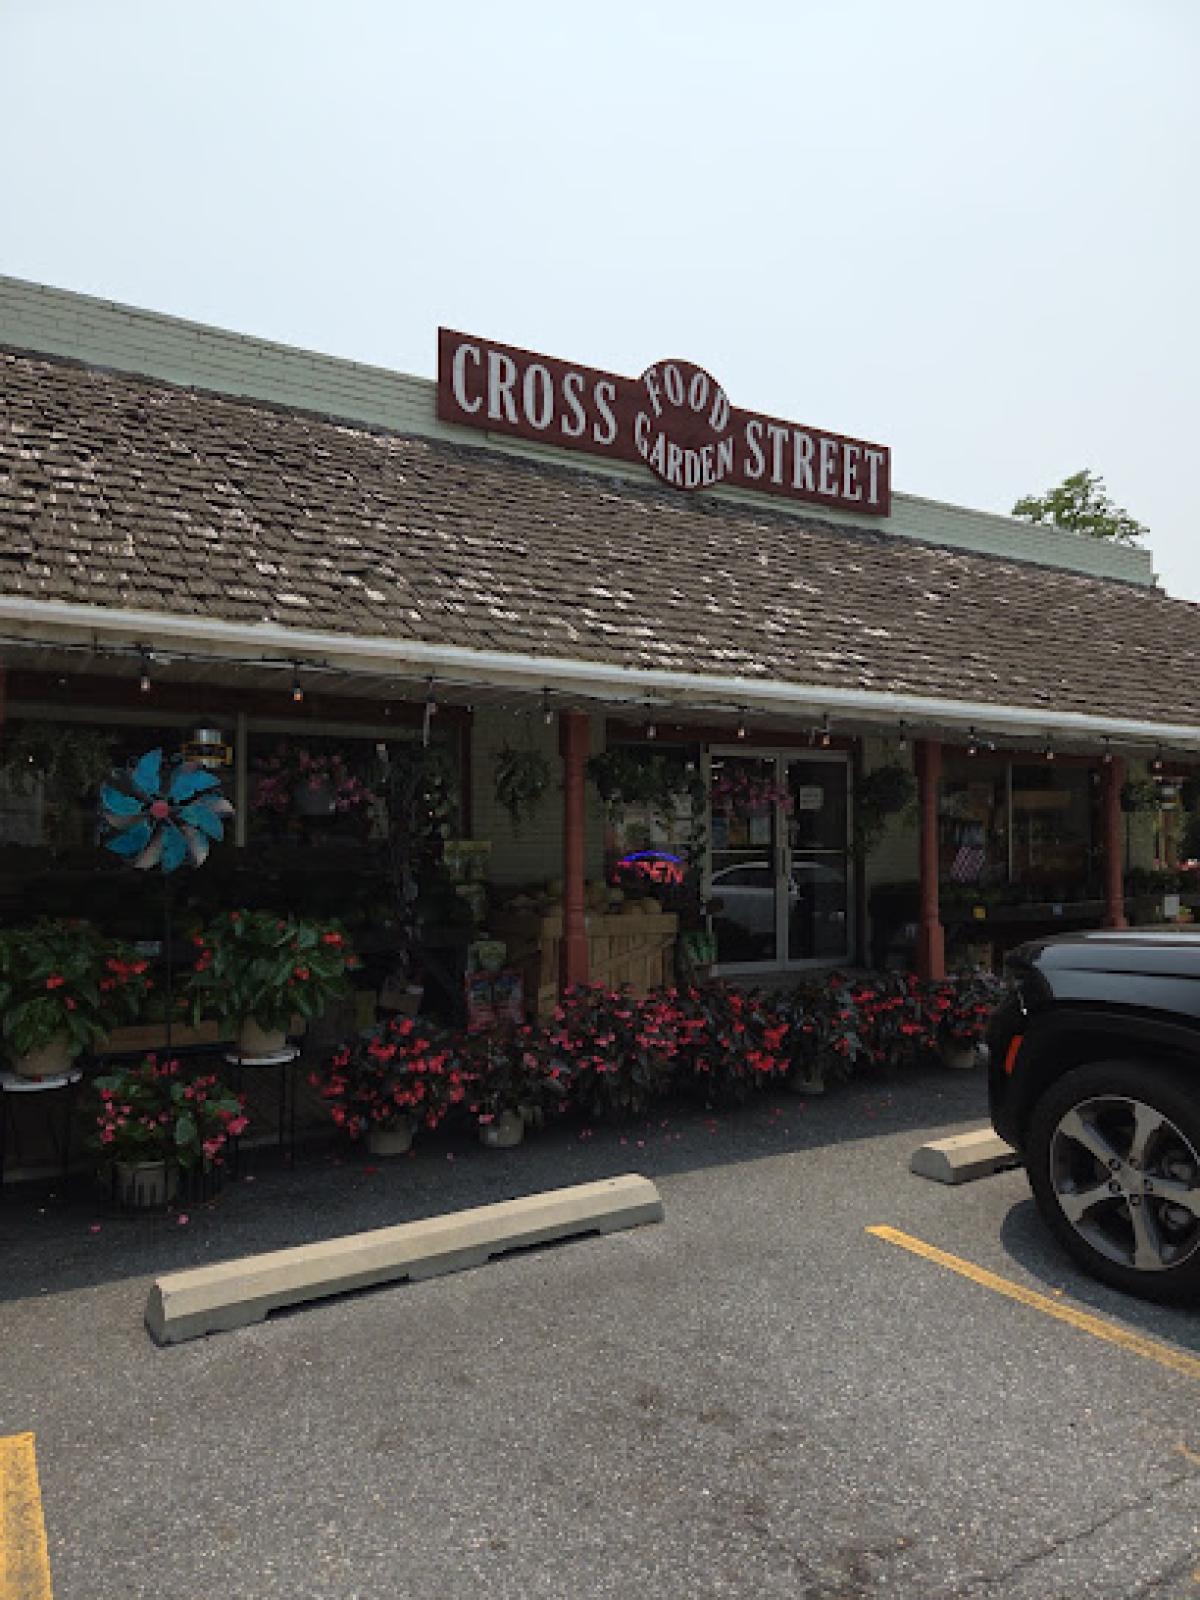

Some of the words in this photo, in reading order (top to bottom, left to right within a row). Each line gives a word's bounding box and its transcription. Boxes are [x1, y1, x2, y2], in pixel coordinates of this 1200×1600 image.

[452, 343, 617, 445] CROSS
[744, 420, 884, 504] STREET
[644, 365, 730, 432] FOOD
[634, 411, 733, 488] GARDEN
